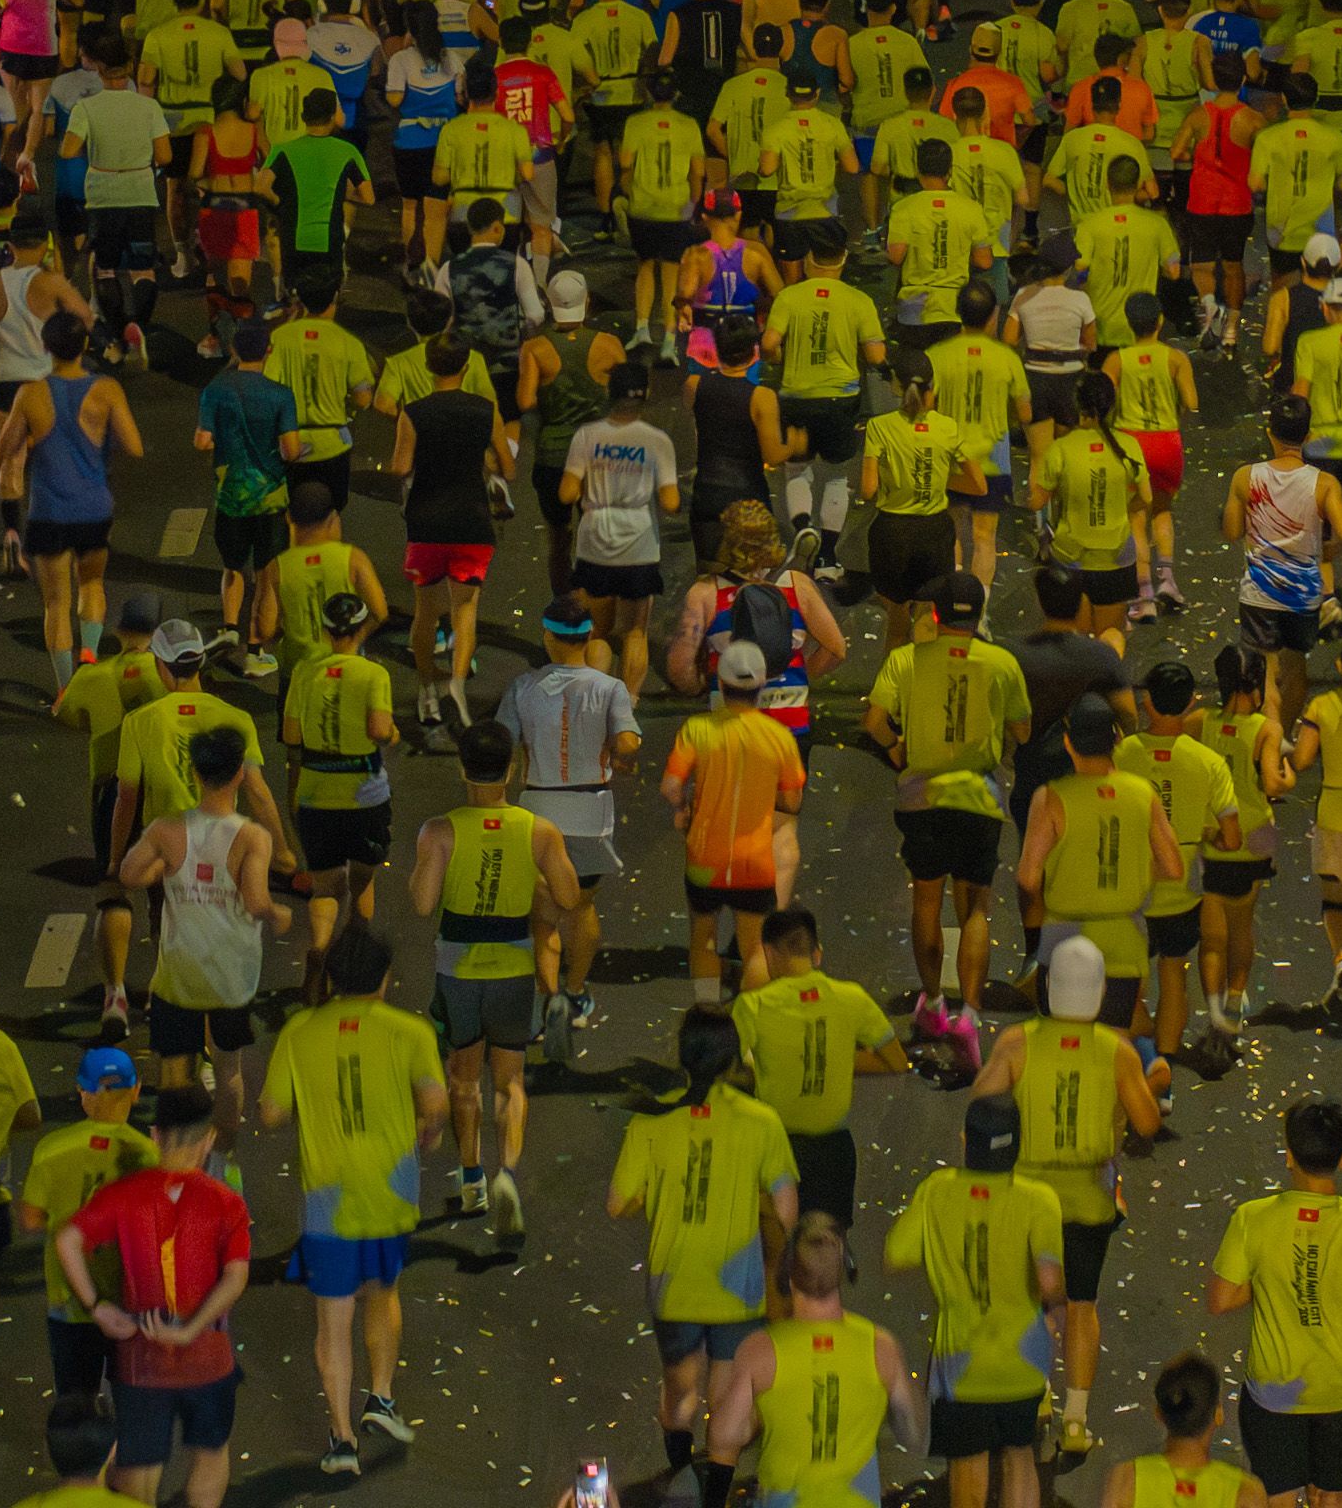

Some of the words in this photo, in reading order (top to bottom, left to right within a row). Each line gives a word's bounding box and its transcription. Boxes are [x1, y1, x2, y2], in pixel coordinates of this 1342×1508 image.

[594, 443, 645, 464] HOKA
[1306, 1261, 1319, 1279] CHI
[1310, 1306, 1323, 1327] CITY
